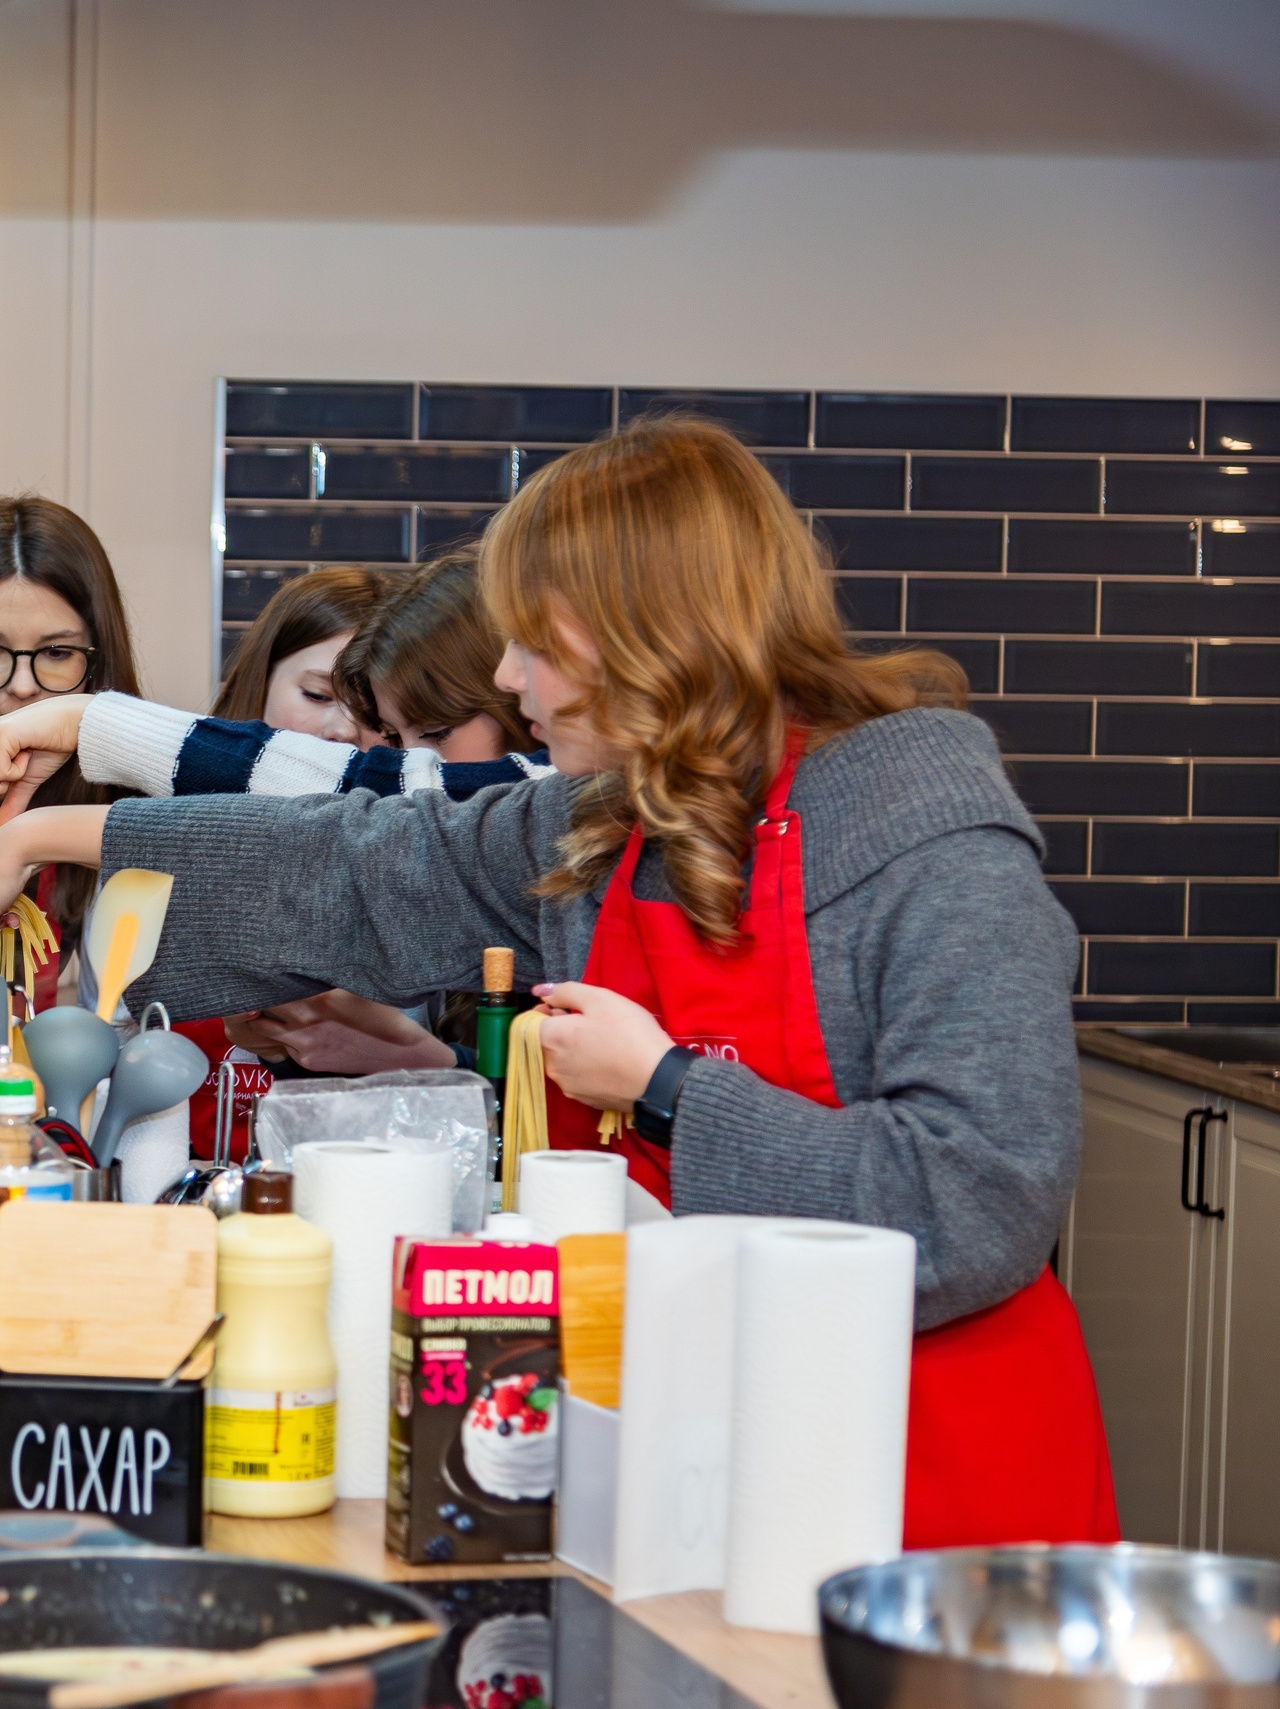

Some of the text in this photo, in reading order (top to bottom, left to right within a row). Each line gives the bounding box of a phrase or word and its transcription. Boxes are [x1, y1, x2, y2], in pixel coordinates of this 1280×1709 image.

[422, 1269, 554, 1305] ПЕТМОЛ
[421, 1361, 467, 1405] 33
[11, 1421, 171, 1515] САХАР
